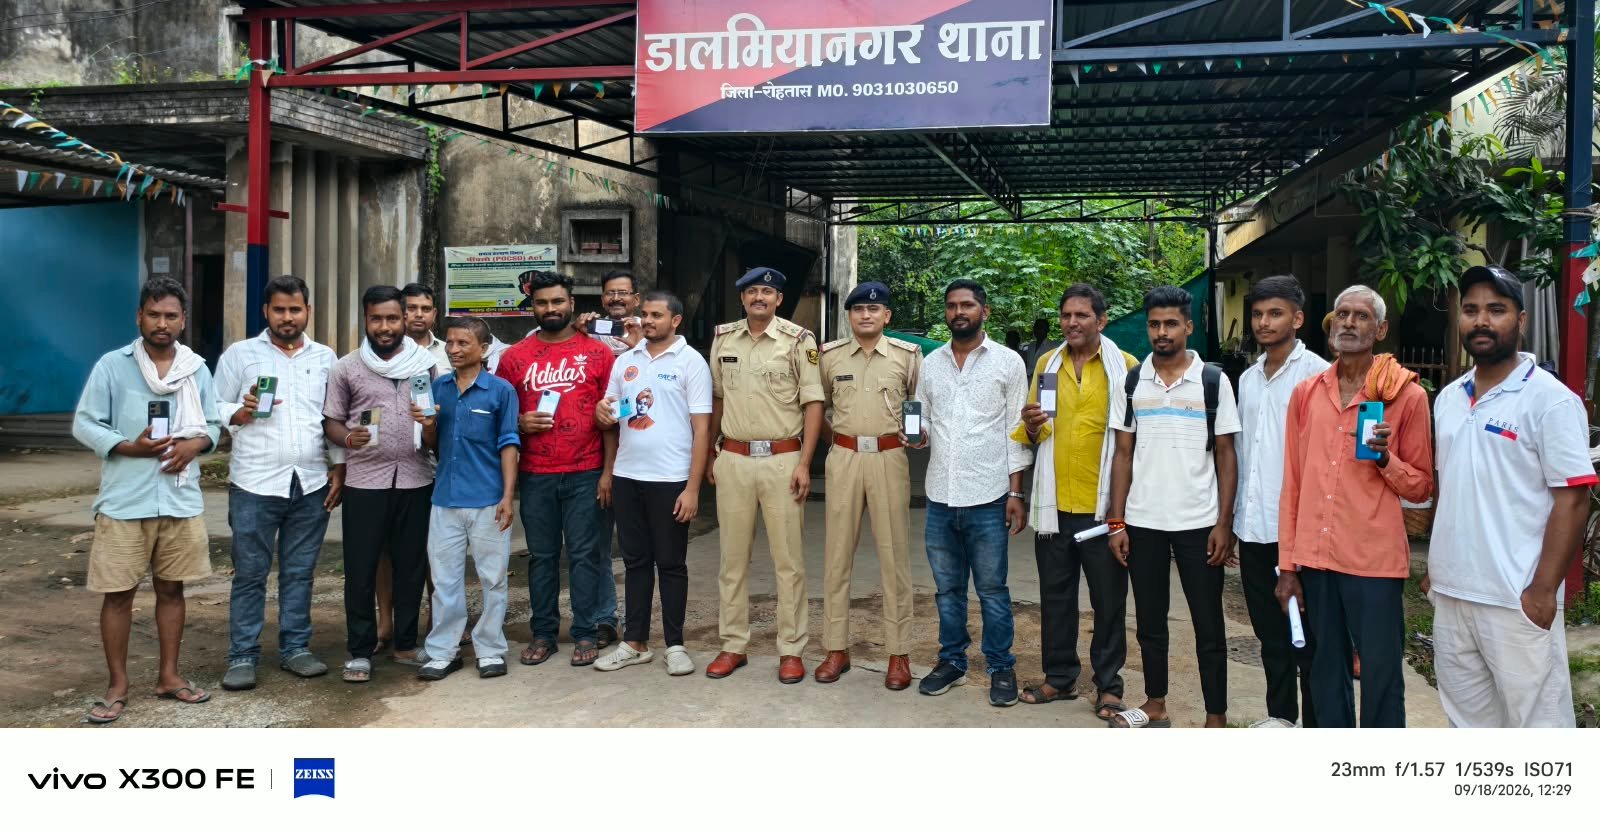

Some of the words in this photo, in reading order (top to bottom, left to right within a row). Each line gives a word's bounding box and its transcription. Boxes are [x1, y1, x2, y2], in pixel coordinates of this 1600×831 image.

[644, 13, 924, 72] डालमियानगर
[938, 20, 1045, 63] थाना
[721, 80, 812, 101] जिला-रोहतास
[817, 83, 848, 98] MO.
[852, 80, 959, 97] 9031030650
[523, 358, 587, 391] Adidas
[1488, 417, 1519, 433] PARIS
